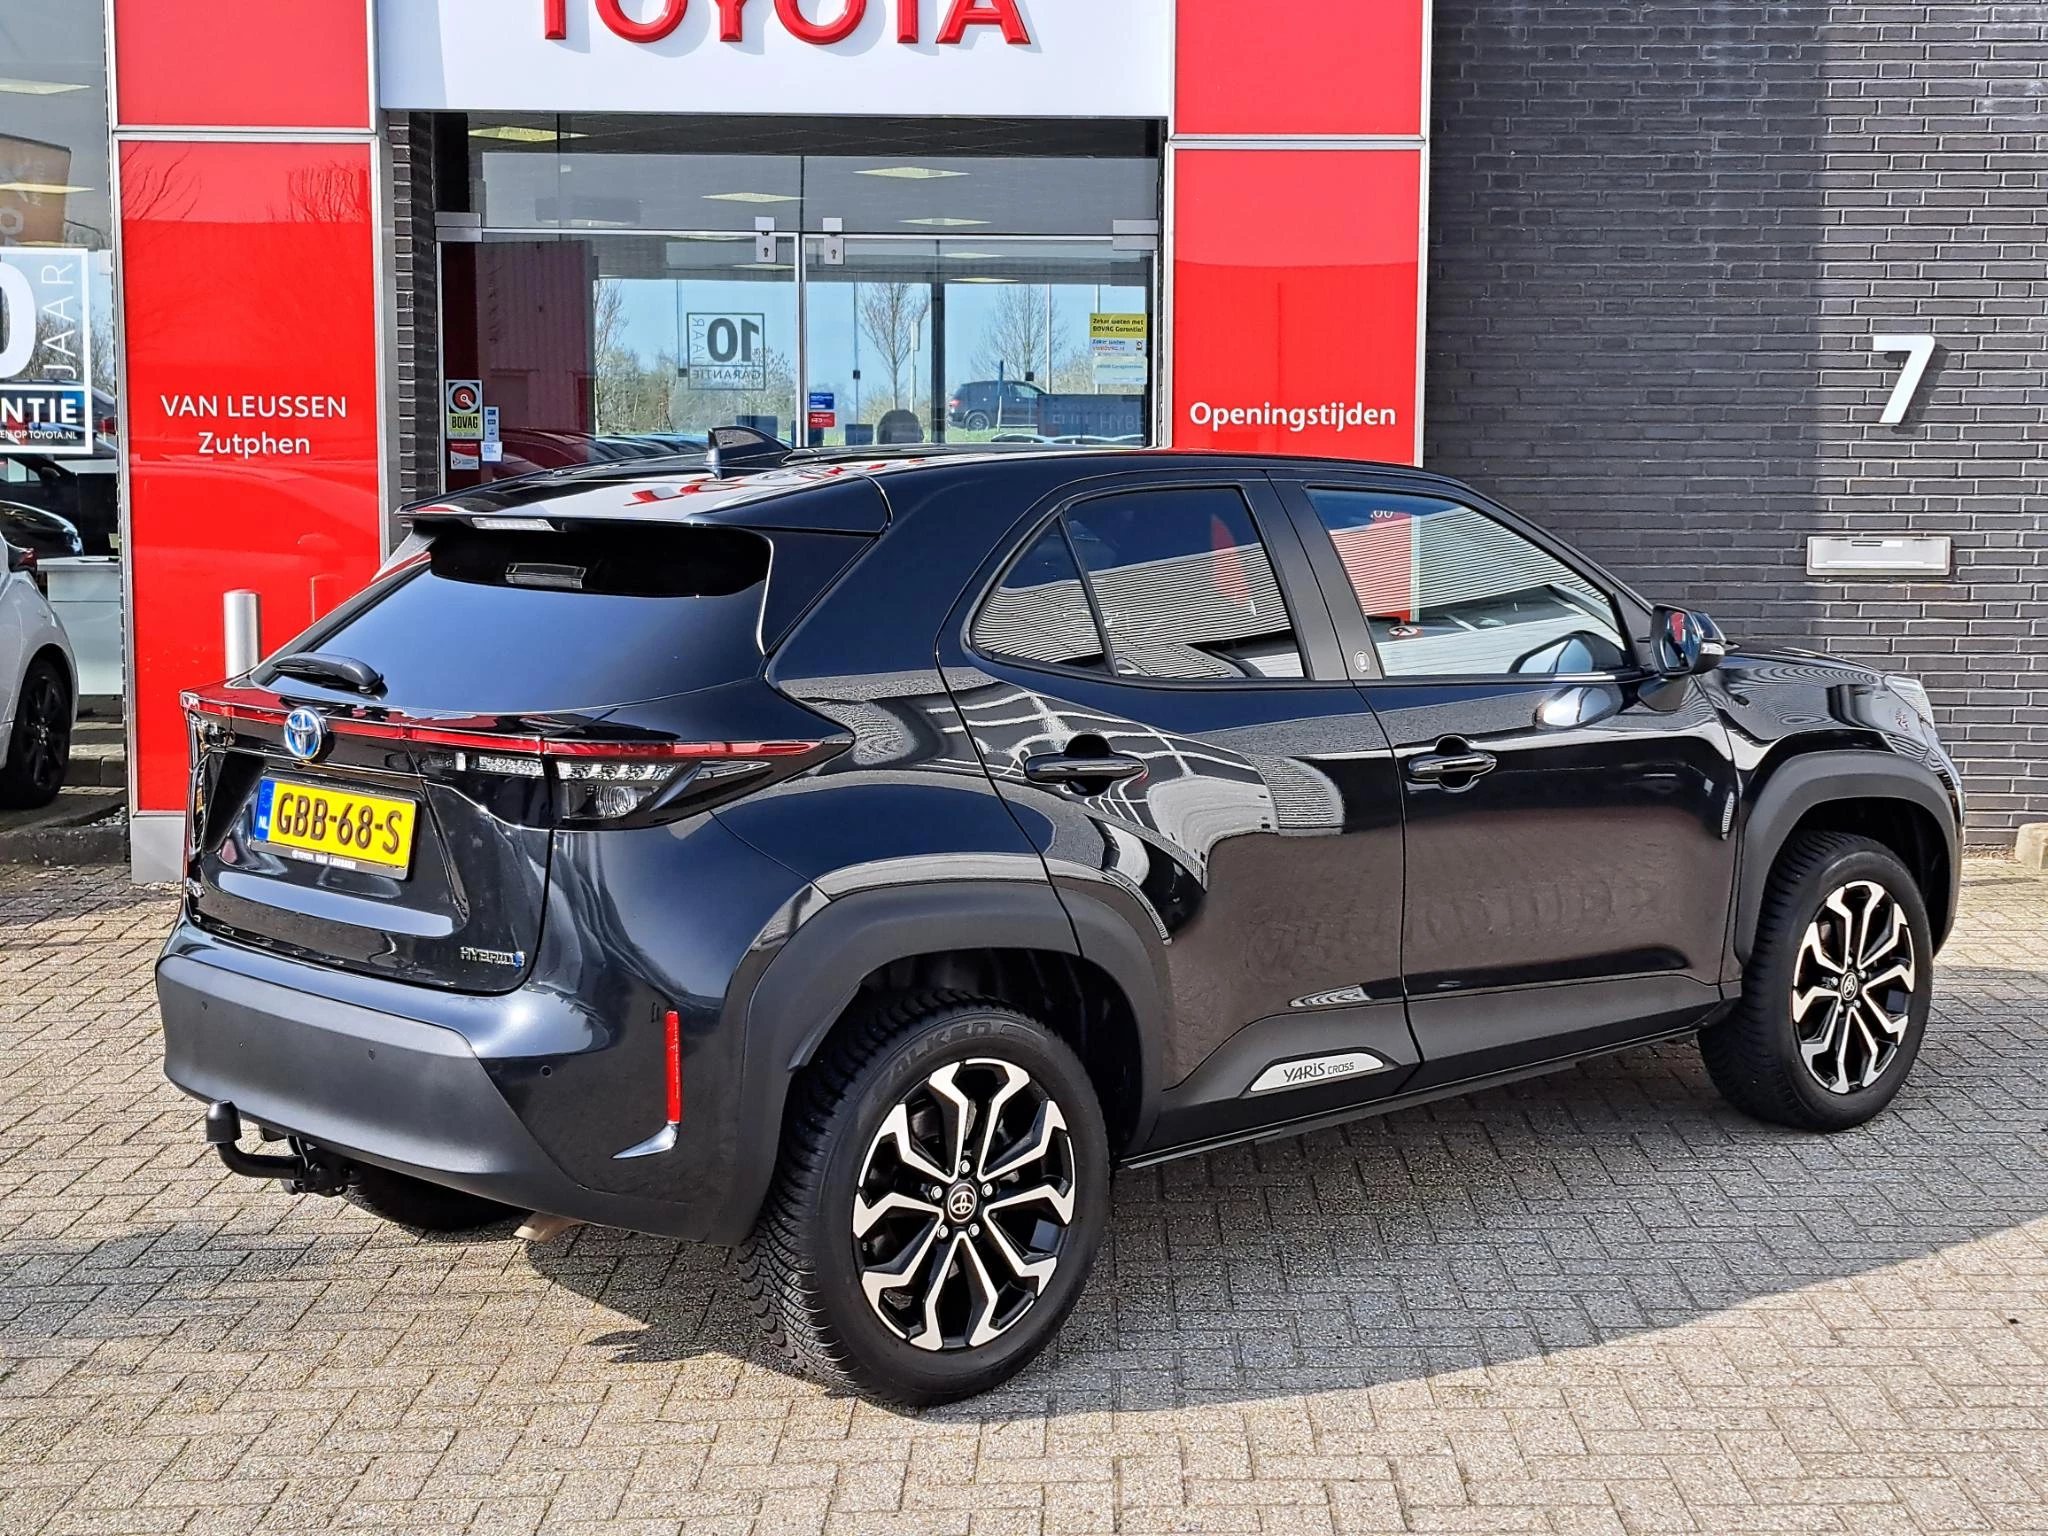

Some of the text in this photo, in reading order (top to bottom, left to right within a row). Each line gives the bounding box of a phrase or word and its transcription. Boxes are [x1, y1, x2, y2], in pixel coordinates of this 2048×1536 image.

[41, 262, 77, 380] JAAR
[1873, 335, 1936, 423] 7
[160, 395, 348, 418] VAN LEUSSEN
[1190, 401, 1396, 432] Openingstijden
[451, 416, 478, 428] BOVAG
[14, 431, 27, 439] OP
[29, 431, 78, 439] TOYOTA.NL
[198, 431, 311, 459] Zutphen
[258, 816, 269, 830] NL
[276, 792, 403, 855] GBB-68-S
[1327, 1062, 1355, 1075] CROSS
